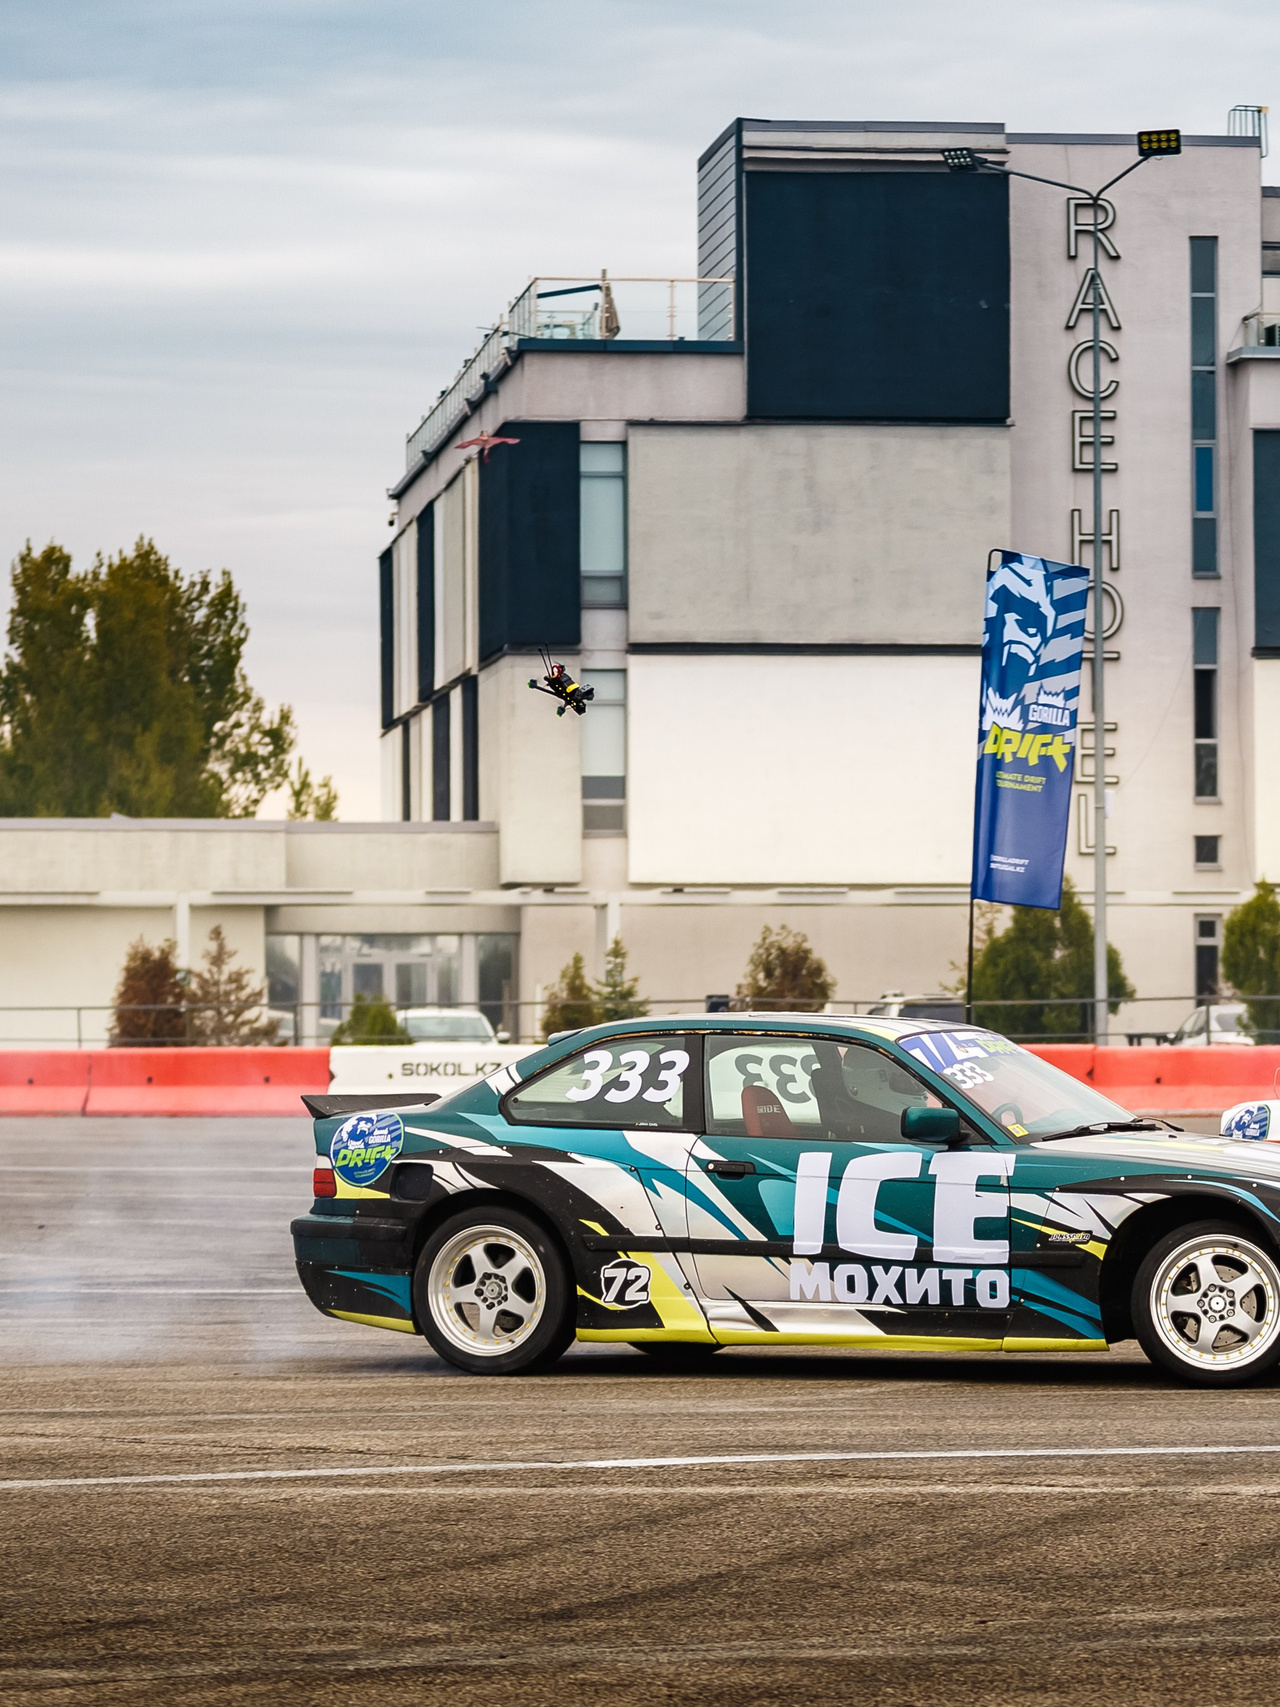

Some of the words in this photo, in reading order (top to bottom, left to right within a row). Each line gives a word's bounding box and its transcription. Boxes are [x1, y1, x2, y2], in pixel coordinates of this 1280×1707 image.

[1065, 197, 1122, 473] RACE
[1028, 704, 1071, 726] GORILLA
[983, 723, 1071, 773] DRIFT
[565, 1050, 690, 1103] 333
[943, 1061, 994, 1089] 333
[336, 1145, 397, 1168] DRIFT
[793, 1152, 1016, 1264] ICE
[604, 1267, 649, 1301] 72
[790, 1262, 1010, 1308] МОХИТО
